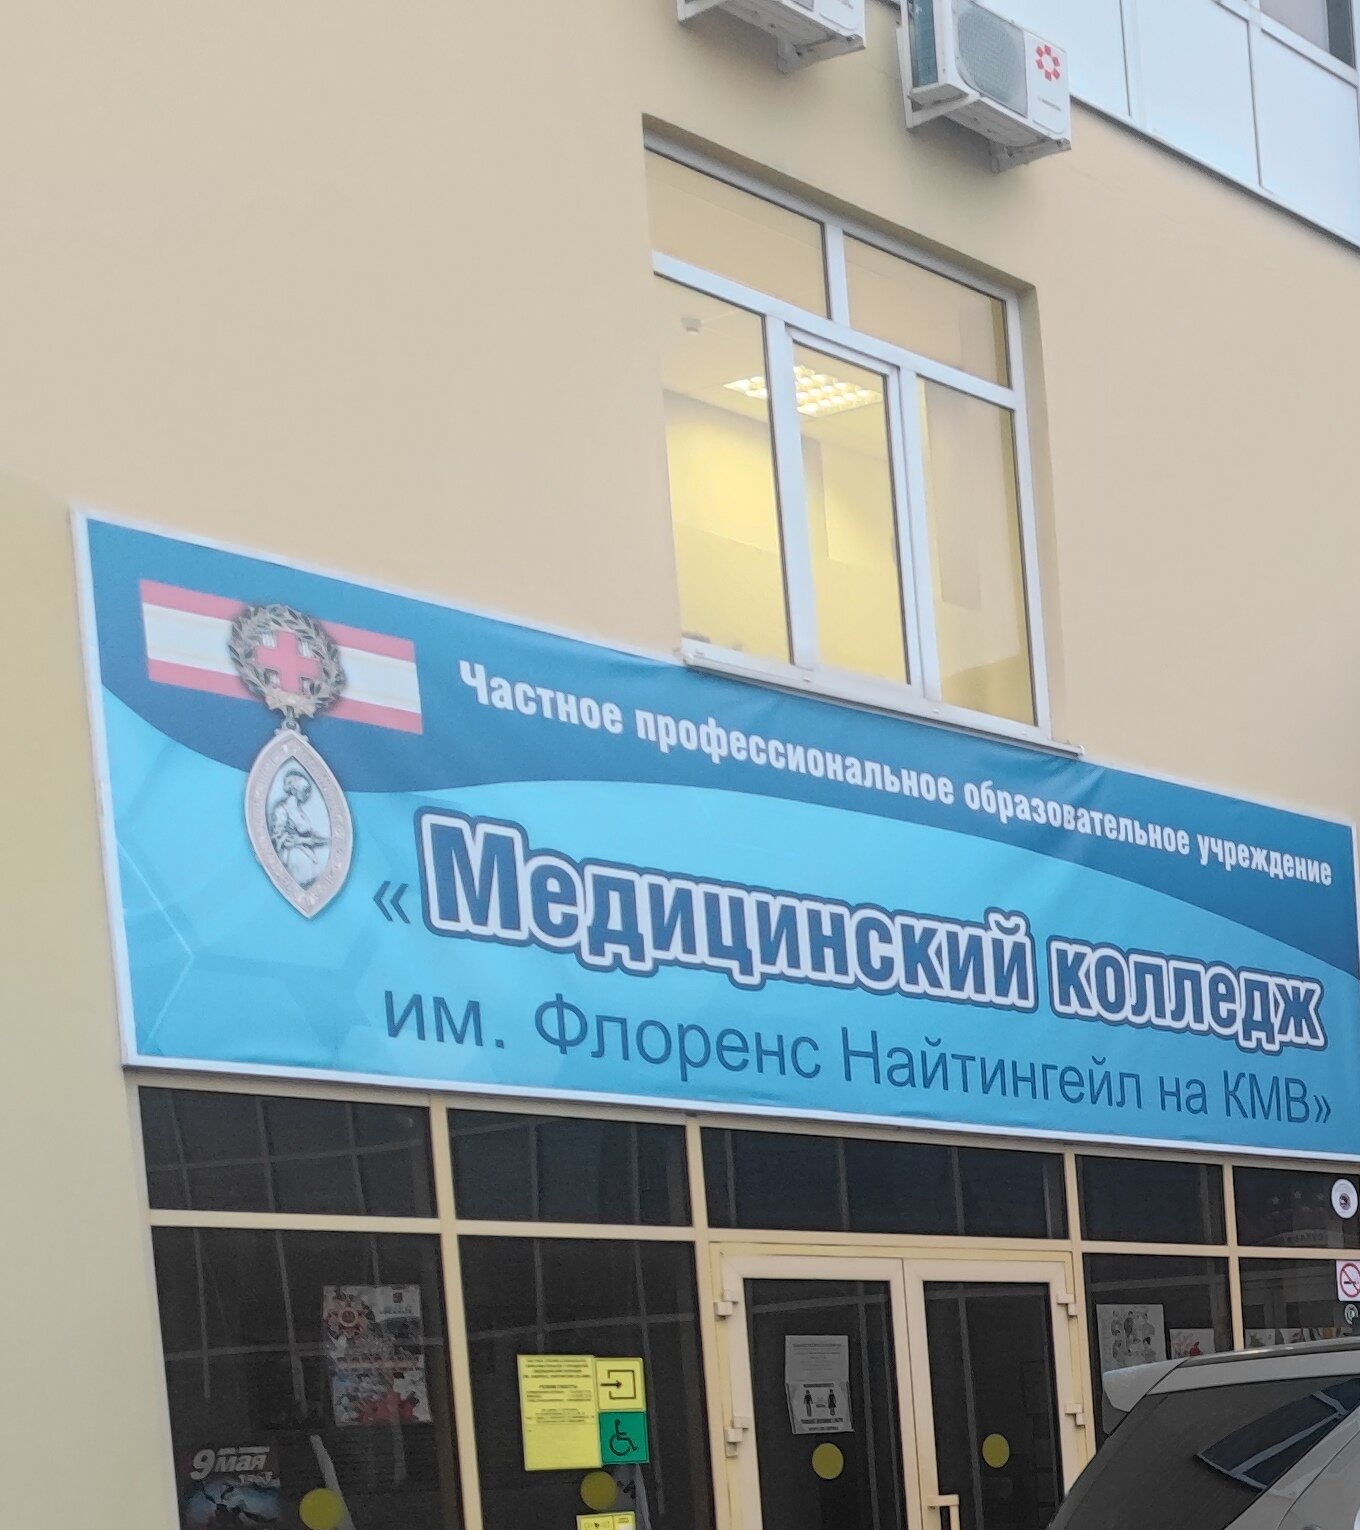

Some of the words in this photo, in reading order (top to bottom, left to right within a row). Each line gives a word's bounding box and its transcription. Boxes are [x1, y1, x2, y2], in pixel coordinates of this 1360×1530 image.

[458, 659, 624, 735] Частное
[635, 708, 956, 806] профессиональное
[964, 780, 1190, 856] образовательное
[1197, 833, 1333, 887] учреждение
[384, 990, 505, 1050] им.
[534, 993, 821, 1082] Флоренс
[841, 1026, 1142, 1111] Найтингейл
[1159, 1076, 1208, 1116] на
[1223, 1070, 1333, 1125] КМВ»
[1047, 935, 1328, 1056] колледж
[190, 1448, 216, 1480] 9
